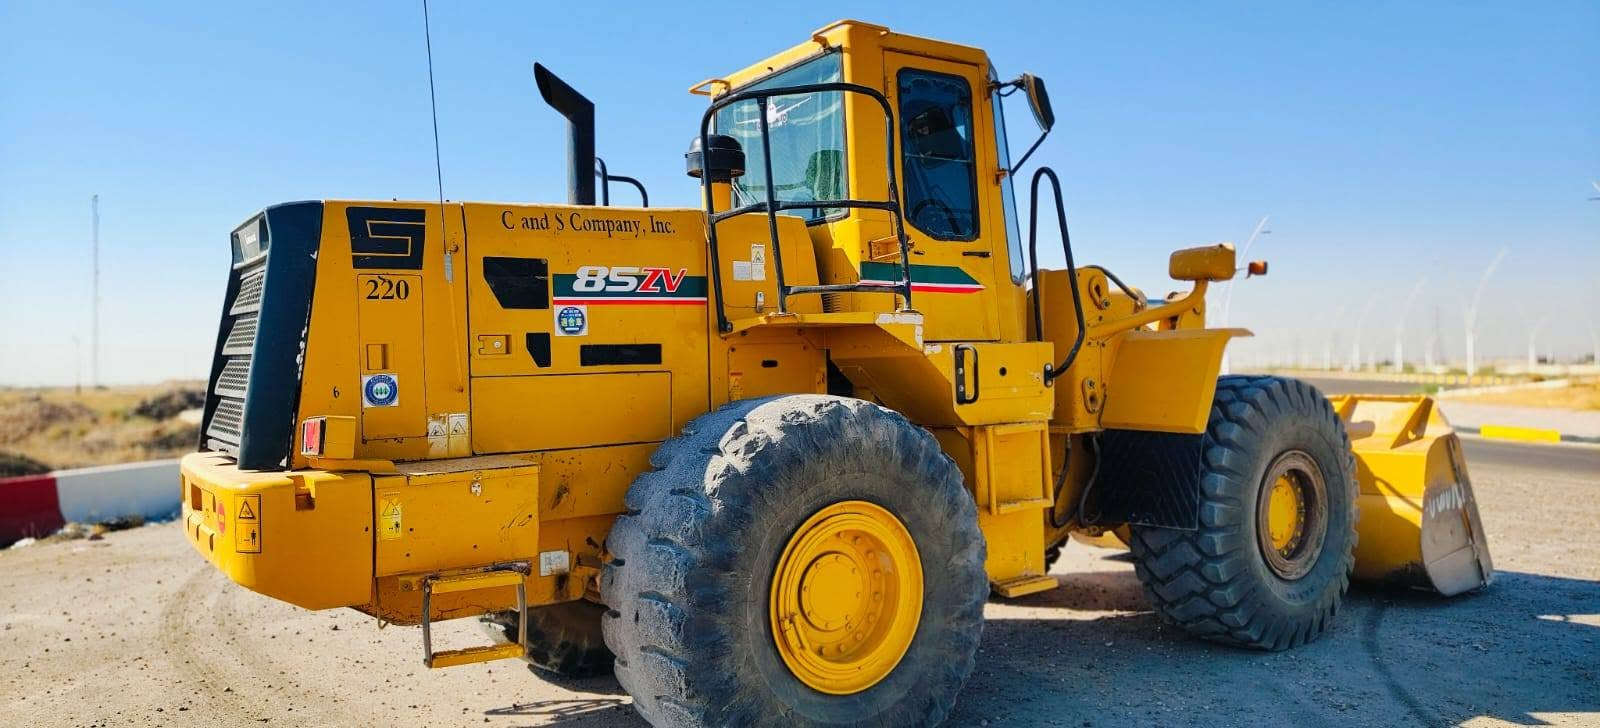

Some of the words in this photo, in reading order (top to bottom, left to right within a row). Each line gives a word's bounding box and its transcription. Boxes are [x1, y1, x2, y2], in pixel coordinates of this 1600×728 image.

[501, 211, 515, 230] C
[521, 213, 548, 230] and
[554, 213, 565, 231] S
[569, 212, 646, 238] Company,
[650, 215, 676, 234] Inc.
[366, 278, 410, 300] 220
[572, 265, 688, 293] 85ZV
